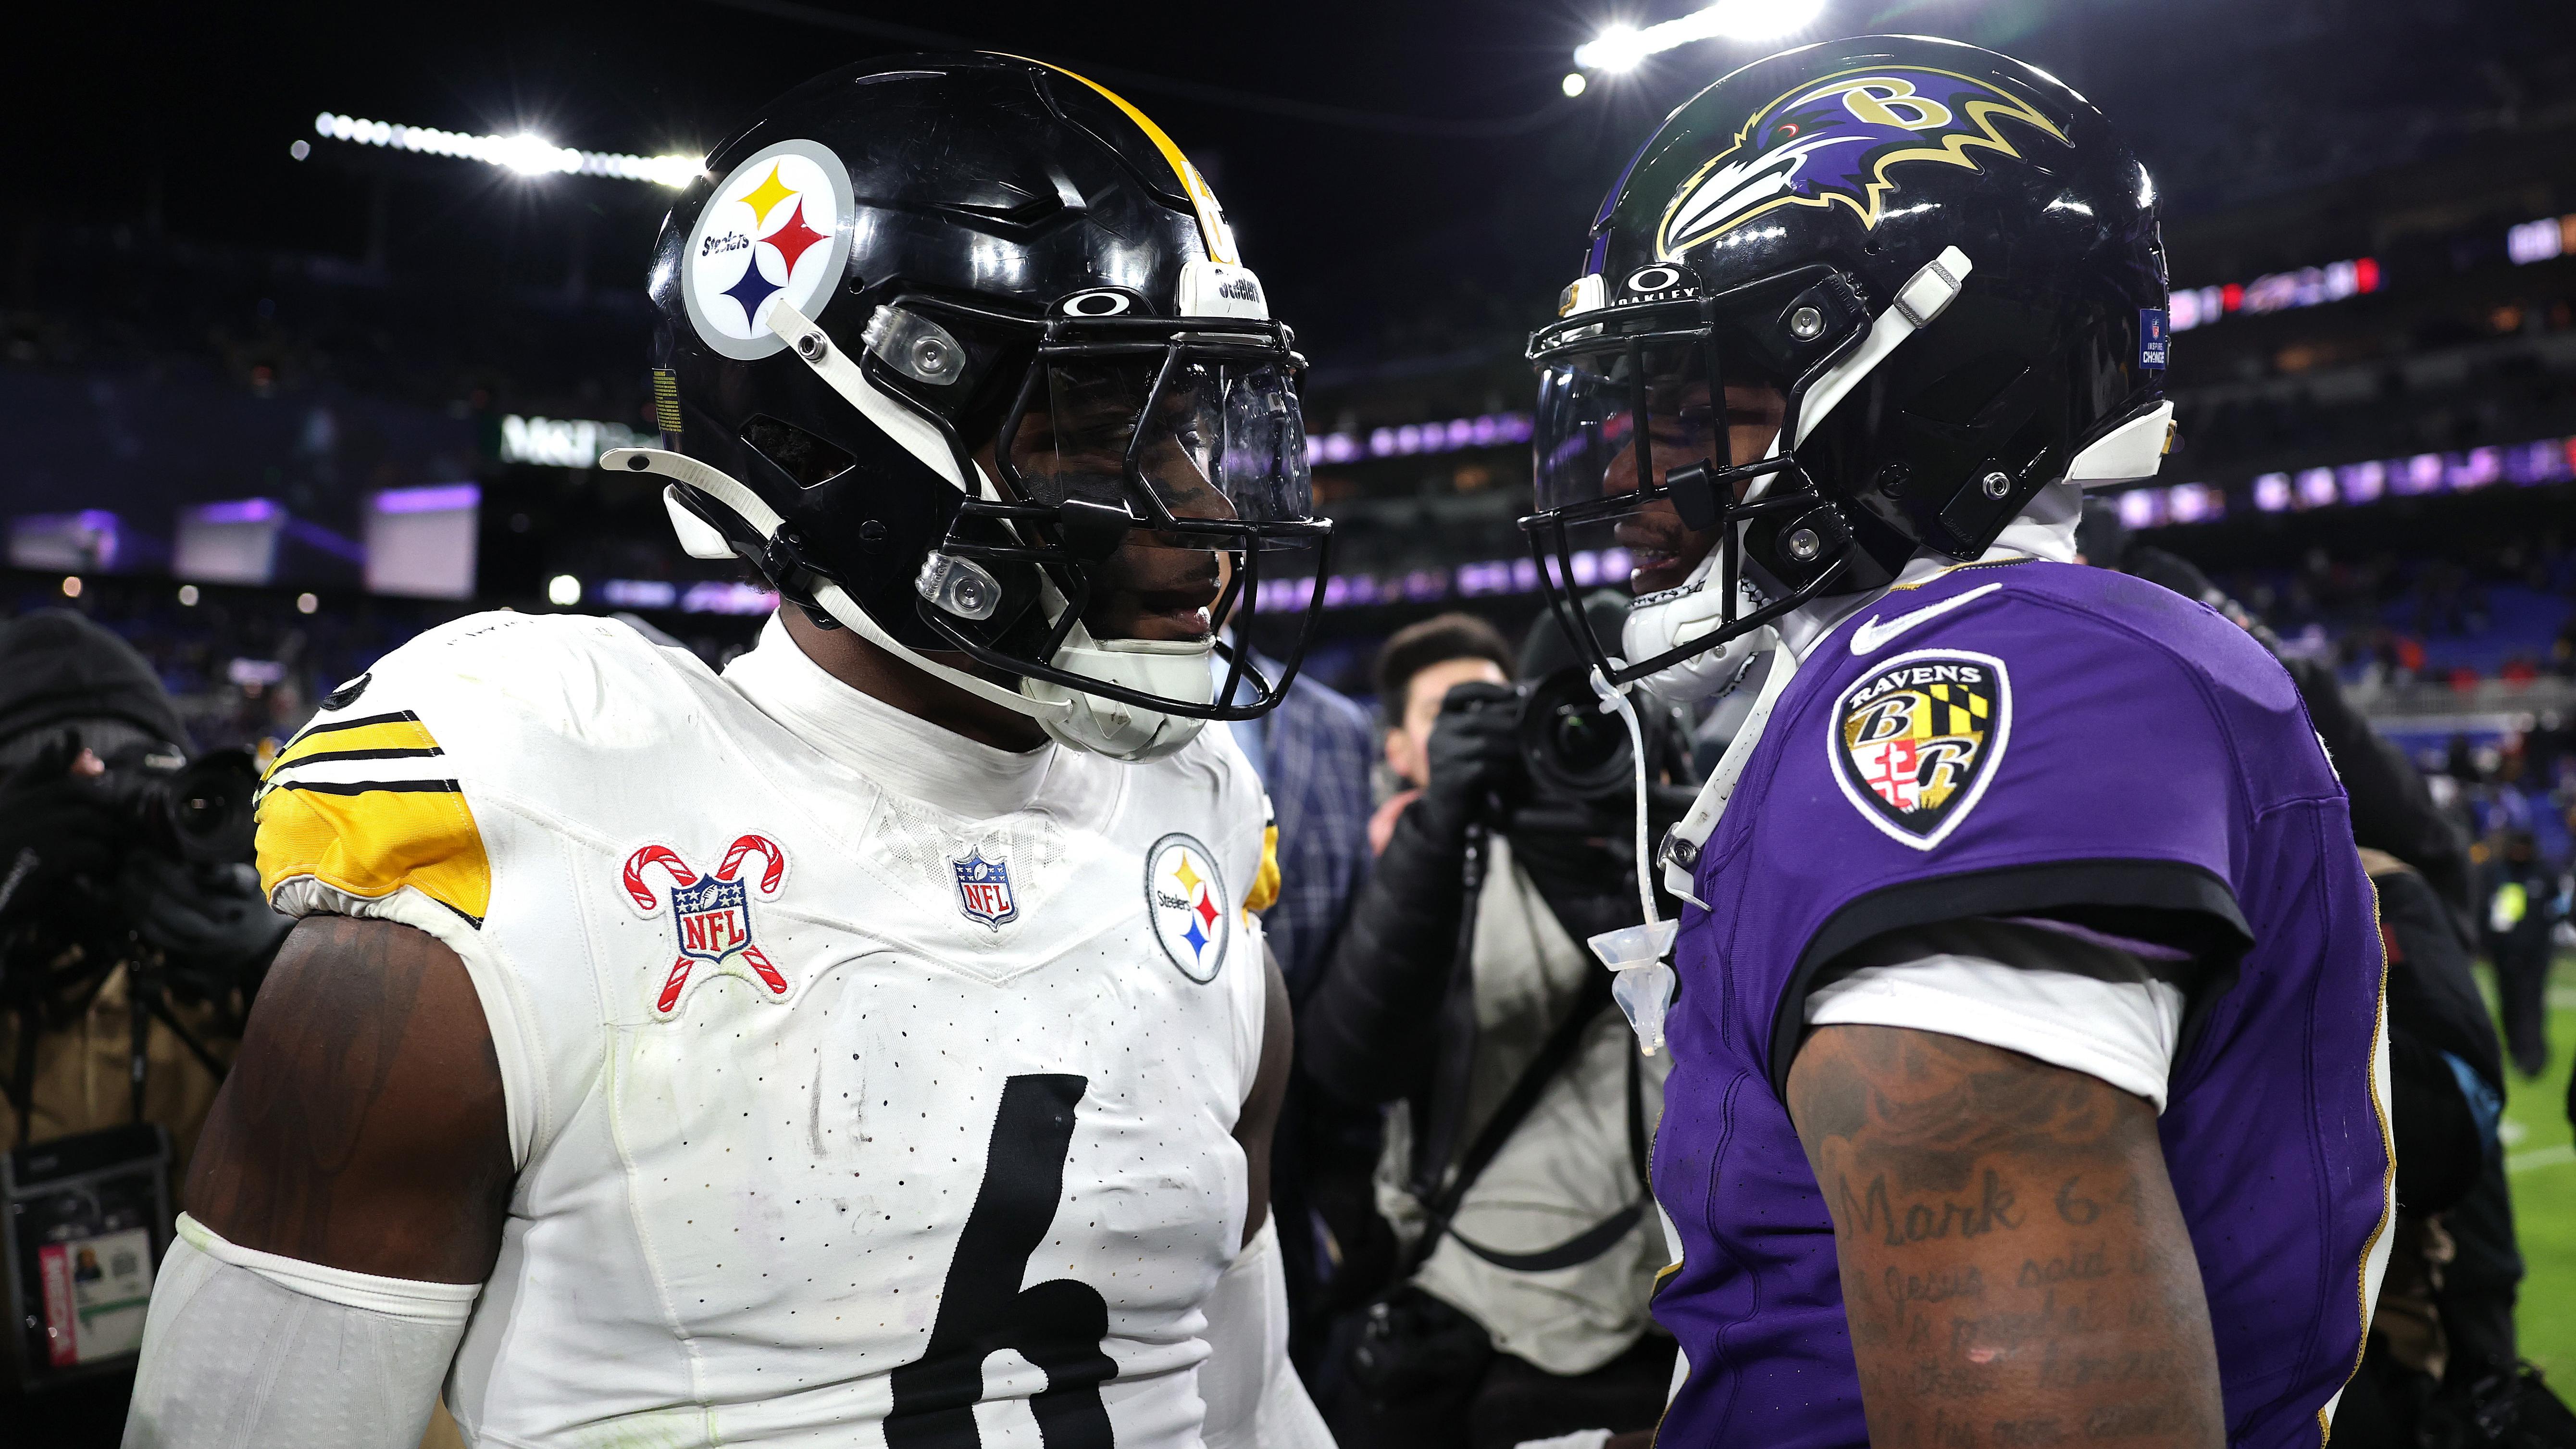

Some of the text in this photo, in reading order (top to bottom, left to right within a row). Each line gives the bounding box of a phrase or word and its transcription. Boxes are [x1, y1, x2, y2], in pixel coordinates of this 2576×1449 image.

[1896, 302, 1922, 325] SPORTSTAR
[2142, 351, 2165, 363] CHANGE
[1849, 665, 1981, 709] RAVENS
[964, 885, 1010, 915] NFL
[1157, 890, 1191, 912] Steelers
[683, 910, 745, 951] NFL
[1839, 1167, 2027, 1246] Mark
[883, 1073, 1119, 1449] 6
